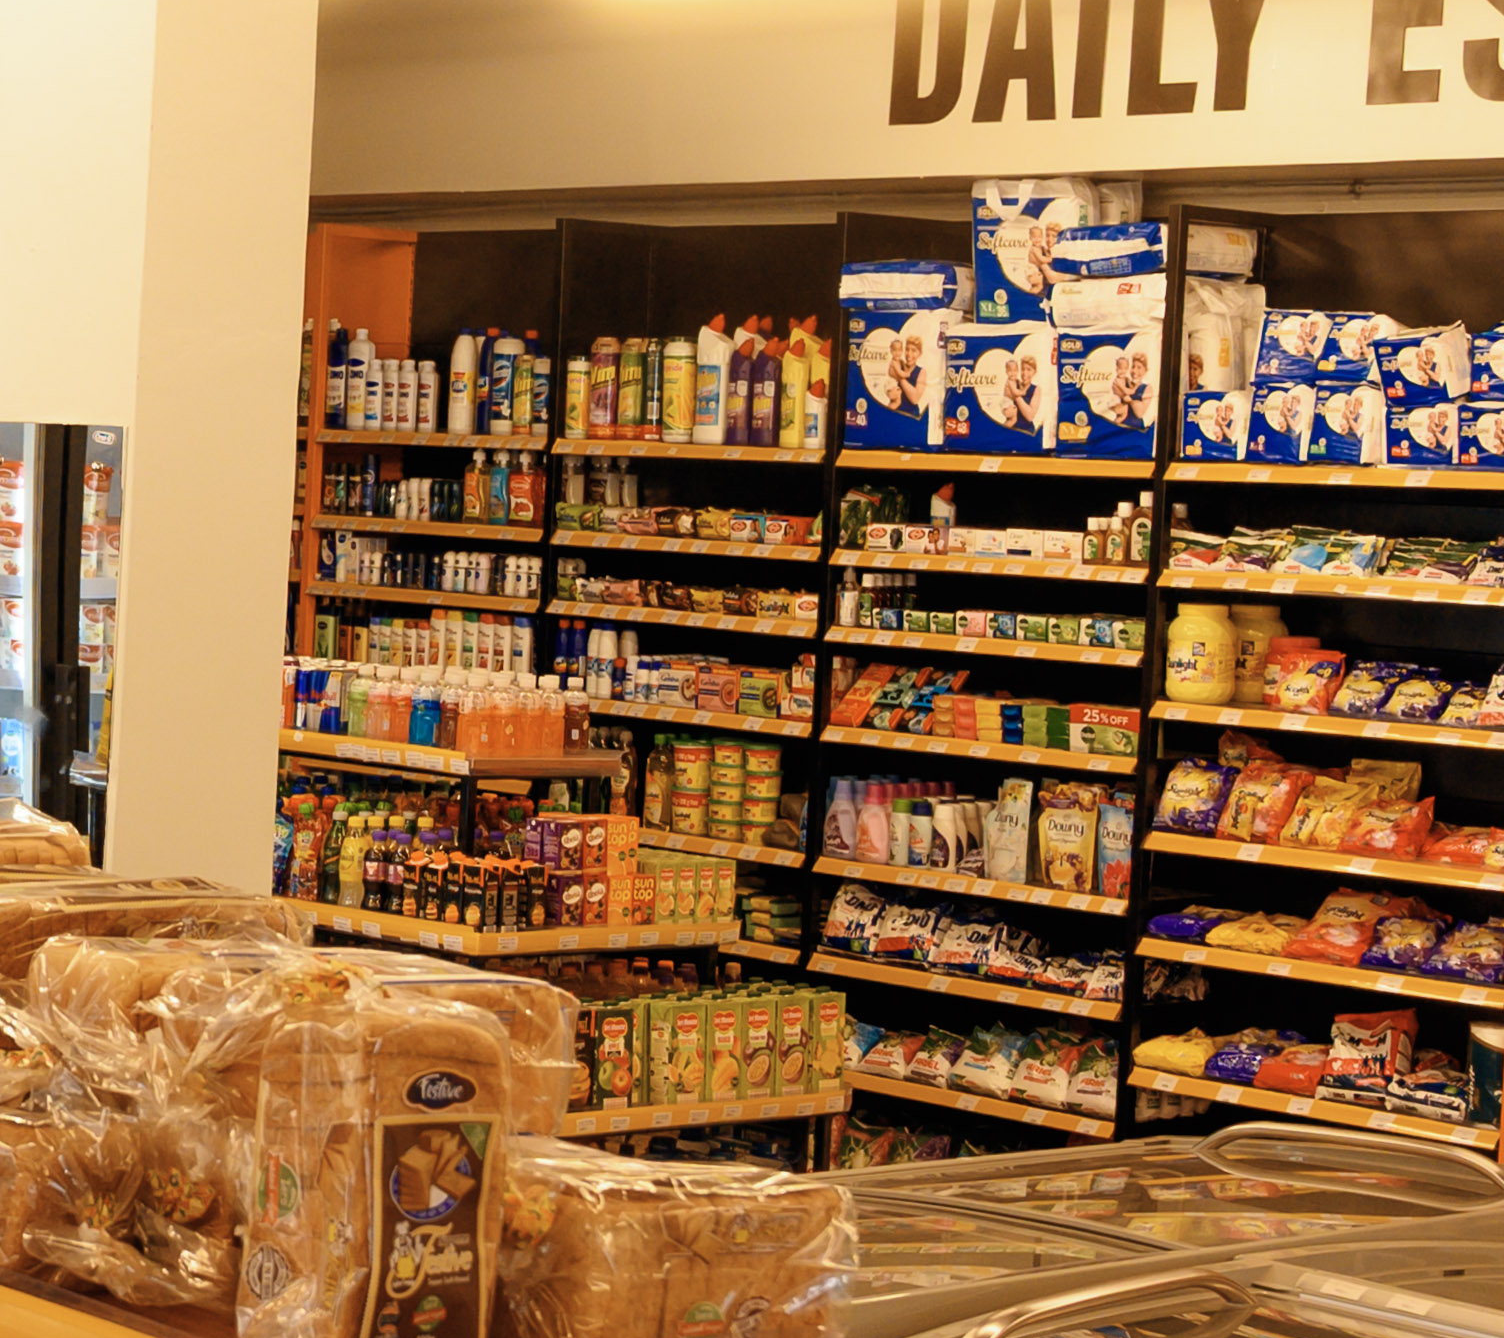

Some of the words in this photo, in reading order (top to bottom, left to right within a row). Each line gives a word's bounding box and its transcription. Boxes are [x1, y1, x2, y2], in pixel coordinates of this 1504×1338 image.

[977, 231, 1030, 255] Softcare
[946, 366, 997, 392] Softcare
[1060, 361, 1113, 391] Softcare
[1111, 717, 1128, 725] OFF
[1048, 819, 1084, 837] Downy
[612, 879, 631, 890] sun
[634, 877, 654, 889] sun
[611, 889, 631, 901] top
[634, 887, 653, 901] top
[418, 1073, 464, 1100] Festive
